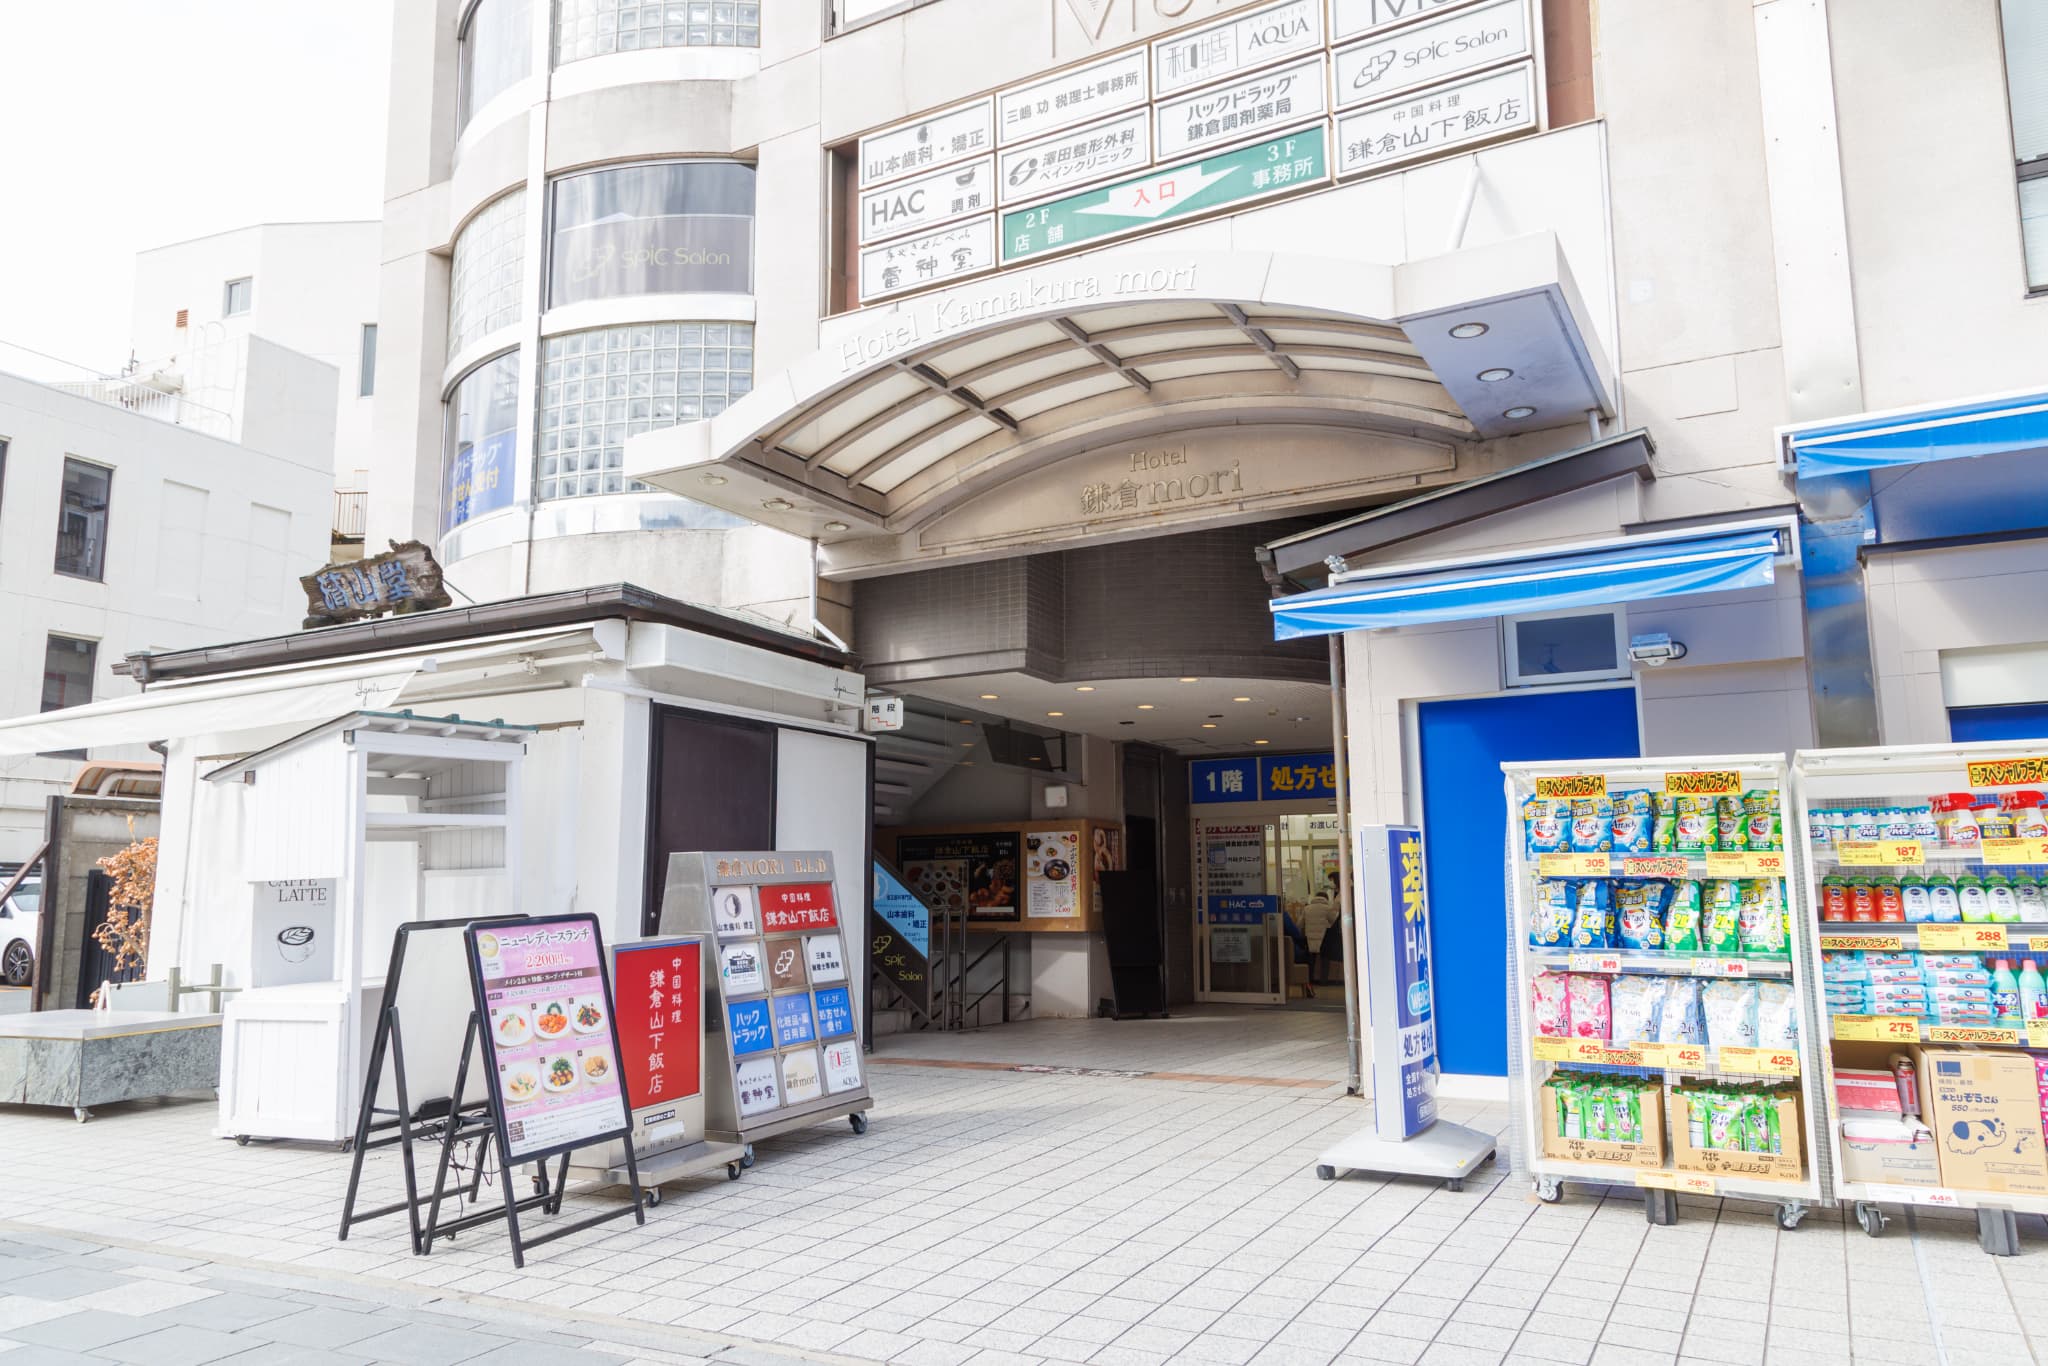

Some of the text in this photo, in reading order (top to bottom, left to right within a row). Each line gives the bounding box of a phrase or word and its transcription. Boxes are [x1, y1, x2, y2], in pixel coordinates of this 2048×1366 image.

[1248, 17, 1310, 50] AQUA
[1455, 28, 1508, 53] Salon
[1055, 71, 1139, 109] 税理士事務所
[1187, 74, 1297, 122] ハックドラッグ
[1393, 94, 1461, 123] 中国料理
[1187, 97, 1292, 142] 鎌倉調剤薬局
[1347, 98, 1521, 162] 鎌倉山下飯店
[1042, 127, 1135, 168] 澤田整形外科
[1039, 146, 1134, 182] ペインクリニック
[1252, 156, 1314, 190] 事務所
[951, 192, 981, 213] 調剤
[1133, 180, 1176, 208] 入口
[871, 189, 925, 226] HAC
[1014, 224, 1064, 253] 店舗
[675, 247, 730, 266] Salon
[882, 248, 974, 288] 雷神堂
[839, 261, 1200, 372] Hotel Kamakura mori
[1129, 444, 1187, 472] Hotel
[872, 703, 896, 714] 階段
[1206, 769, 1243, 793] 1階
[1270, 763, 1337, 791] 処方せ
[1896, 847, 1916, 856] 187
[1585, 859, 1605, 868] 305
[1758, 858, 1779, 867] 305
[278, 887, 327, 903] LATTE
[781, 892, 811, 904] 中国料理
[1229, 901, 1246, 909] HAC
[765, 908, 830, 926] 鎌倉山下飯店
[500, 927, 590, 947] ニューレディースランチ
[1976, 932, 2001, 941] 288
[899, 970, 922, 981] Salon
[671, 957, 683, 1024] 中国料理
[787, 1001, 795, 1010] 1F
[819, 1007, 847, 1020] 処方せん
[736, 1009, 760, 1028] ハック
[826, 1021, 842, 1032] 受付
[1889, 1022, 1914, 1032] 275
[648, 969, 665, 1096] 鎌倉山下飯店
[733, 1025, 769, 1046] ドラッグ
[783, 1026, 807, 1041] 日用品
[1579, 1045, 1600, 1054] 425
[1678, 1050, 1700, 1060] 425
[1771, 1056, 1794, 1065] 425
[843, 1076, 858, 1086] AQUA
[1941, 1093, 1998, 1104] 水とりぞうさん
[1688, 1179, 1709, 1188] 285
